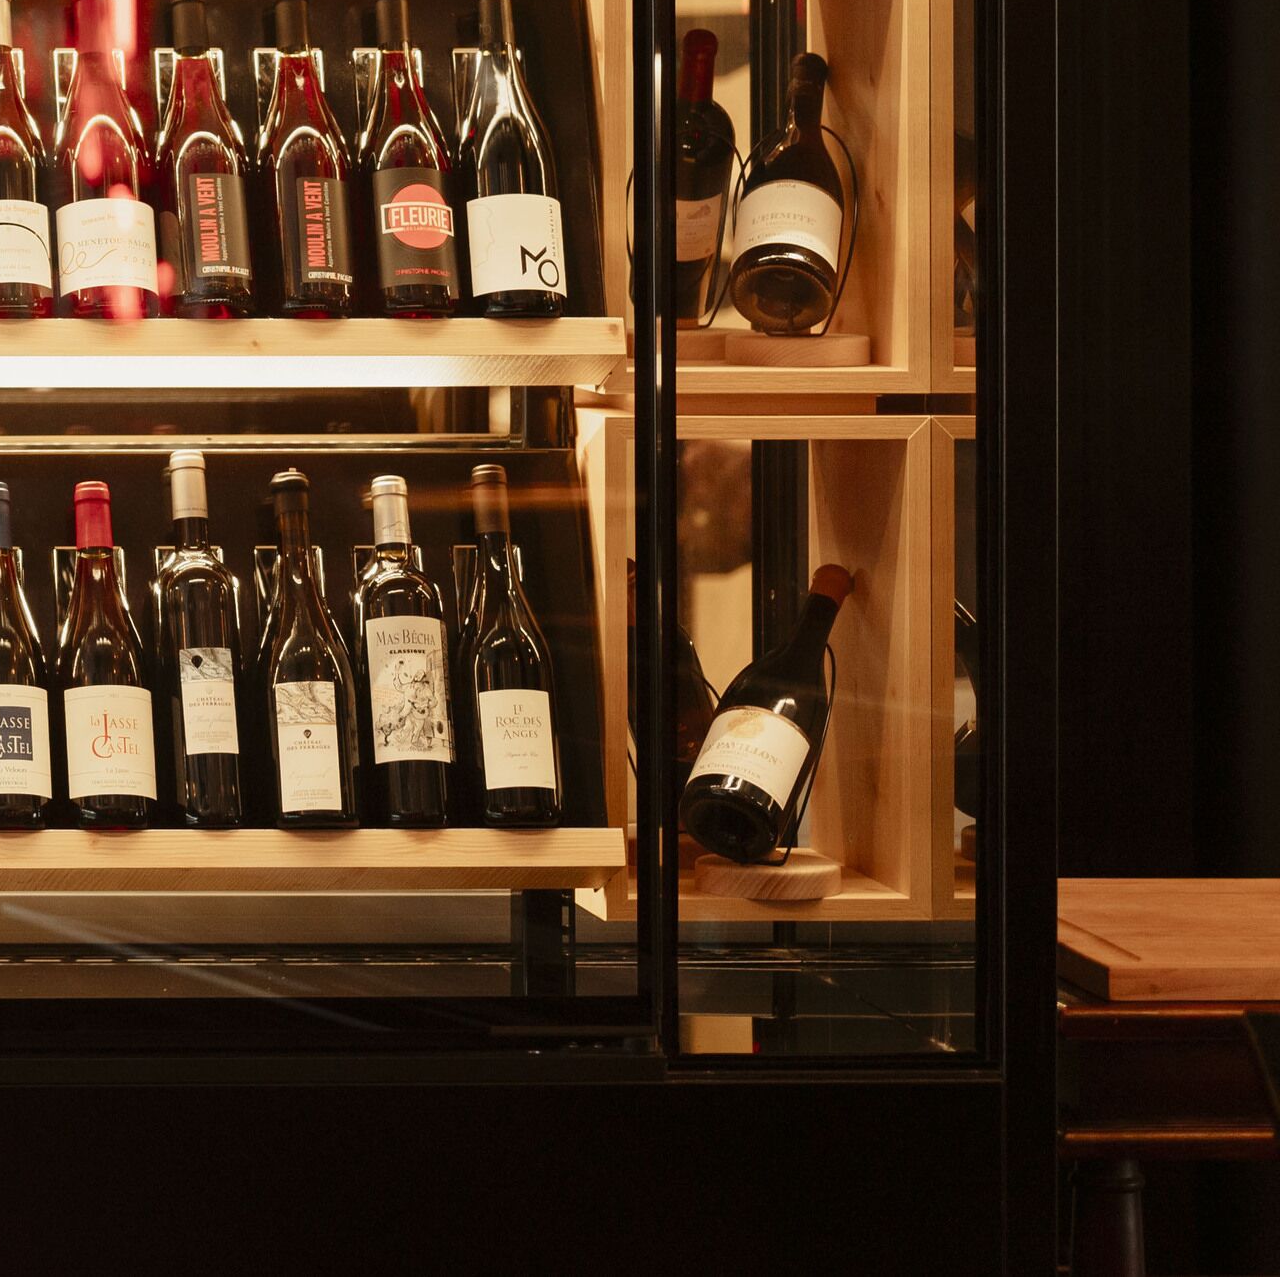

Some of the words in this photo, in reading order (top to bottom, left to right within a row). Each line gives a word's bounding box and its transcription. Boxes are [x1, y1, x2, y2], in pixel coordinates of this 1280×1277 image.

[196, 177, 216, 206] VENT
[303, 181, 323, 210] VENT
[198, 208, 217, 216] A
[305, 212, 324, 221] A
[391, 206, 448, 229] FLEURIE
[199, 218, 221, 262] MOULIN
[305, 223, 326, 268] MOULIN
[376, 630, 400, 646] MAS
[401, 628, 436, 647] BÉCHA
[495, 715, 520, 728] ROC
[522, 715, 543, 727] DES
[513, 704, 523, 716] LE
[90, 716, 100, 727] la
[99, 709, 139, 748] JASSE
[502, 728, 539, 740] ANGES
[91, 734, 141, 759] CASTEL
